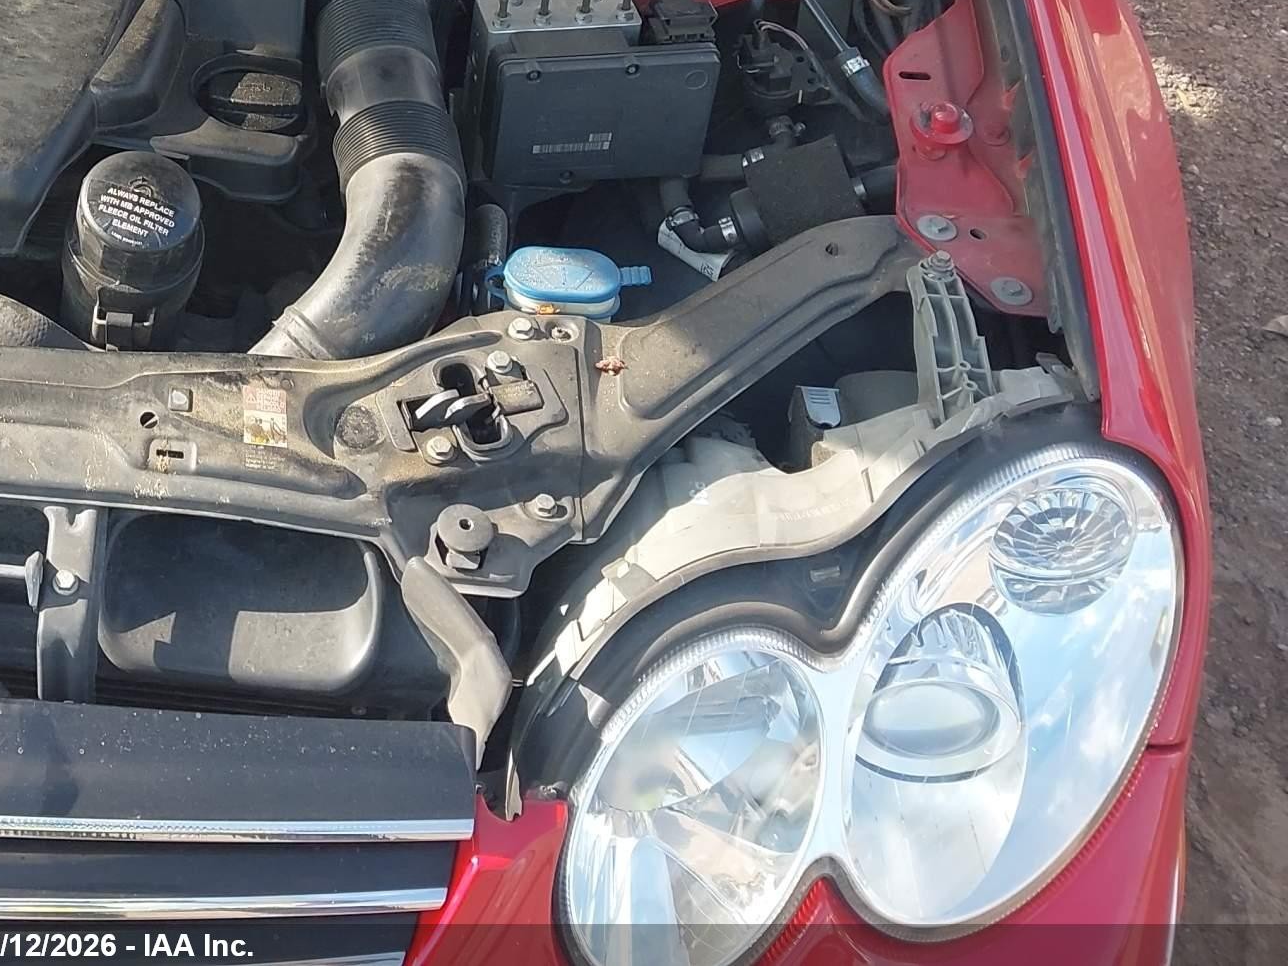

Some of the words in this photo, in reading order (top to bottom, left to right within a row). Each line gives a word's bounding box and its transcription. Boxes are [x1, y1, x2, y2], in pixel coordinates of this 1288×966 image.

[100, 194, 120, 206] WITH
[120, 201, 133, 210] MB
[133, 205, 175, 228] APPROVED
[107, 187, 139, 202] ALWAYS
[139, 197, 175, 218] REPLACE
[98, 204, 129, 219] FLEECE
[129, 214, 142, 225] OIL
[143, 219, 169, 236] FILTER
[112, 218, 149, 237] ELEMENT
